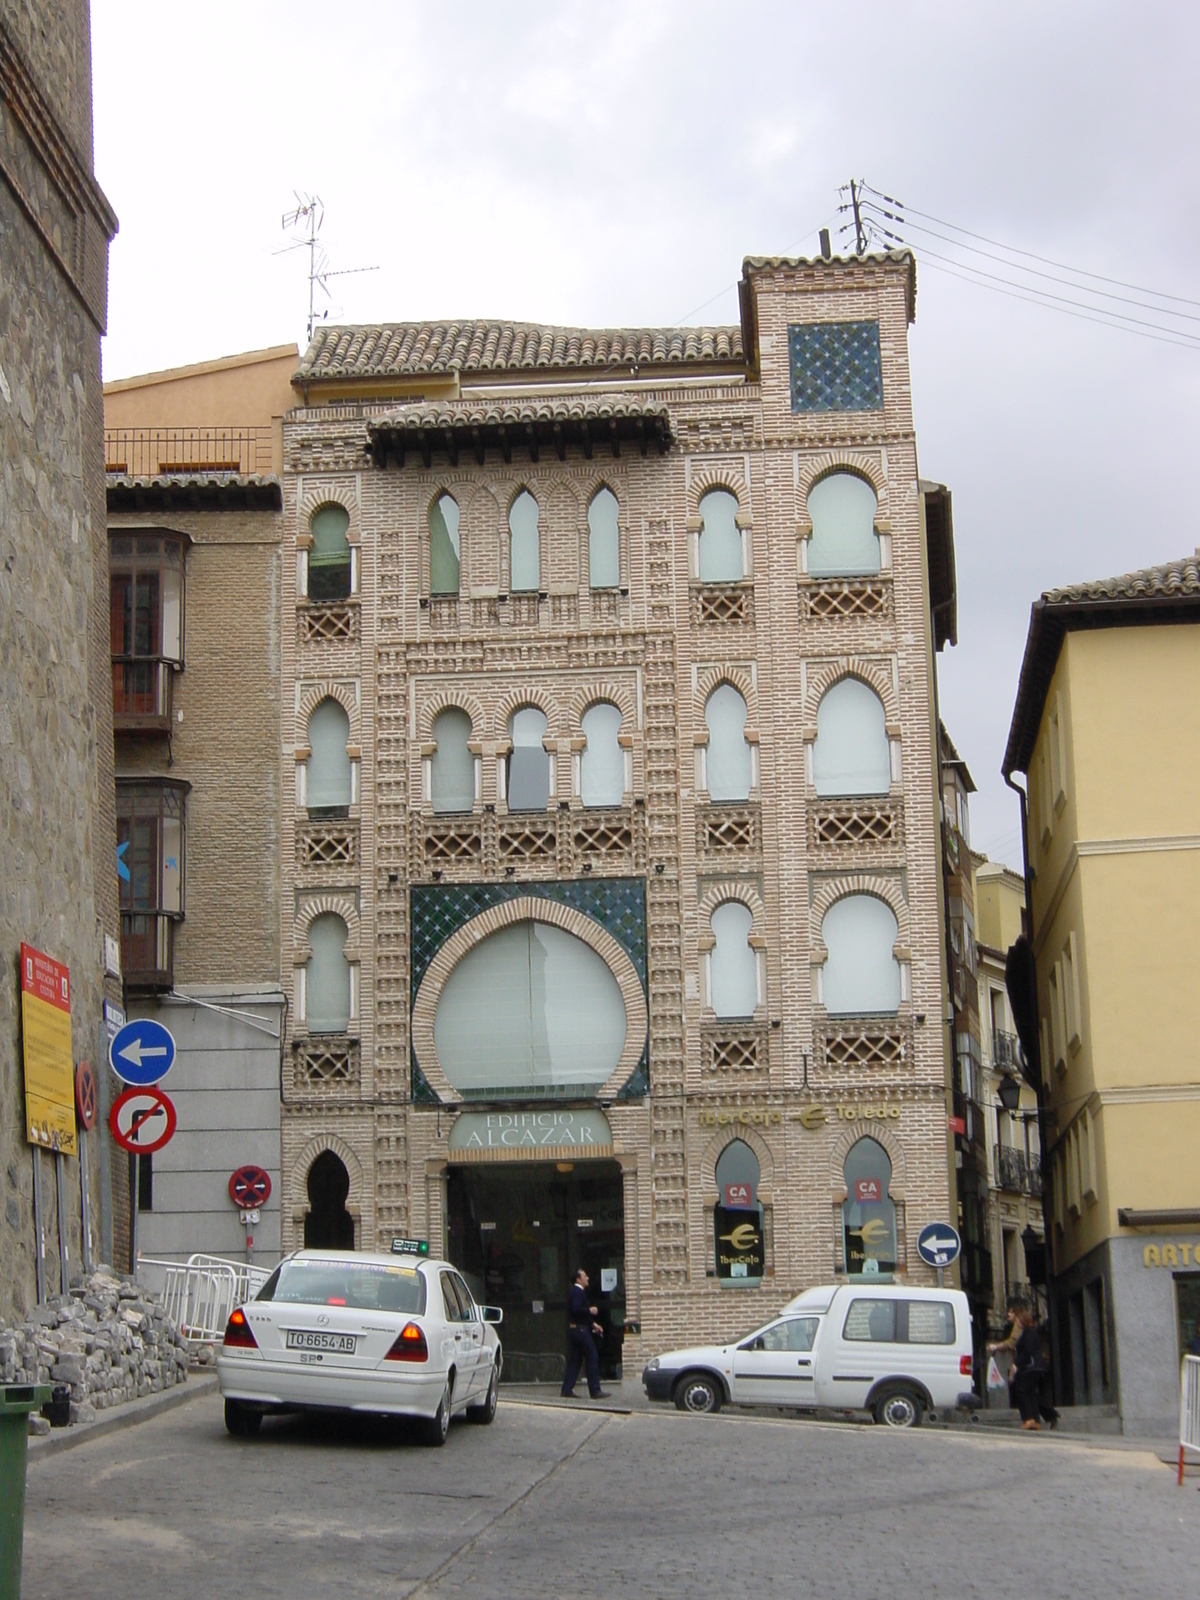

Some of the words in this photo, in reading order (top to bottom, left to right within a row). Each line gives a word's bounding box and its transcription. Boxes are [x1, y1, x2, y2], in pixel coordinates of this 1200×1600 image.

[700, 1108, 782, 1127] iberCaja
[836, 1102, 900, 1120] Toledo
[486, 1113, 574, 1128] EDIFICIO
[466, 1127, 594, 1146] ALCAZAR
[729, 1187, 747, 1197] CA
[859, 1182, 877, 1192] CA
[720, 1255, 759, 1265] iberCaja
[300, 1353, 317, 1363] SP
